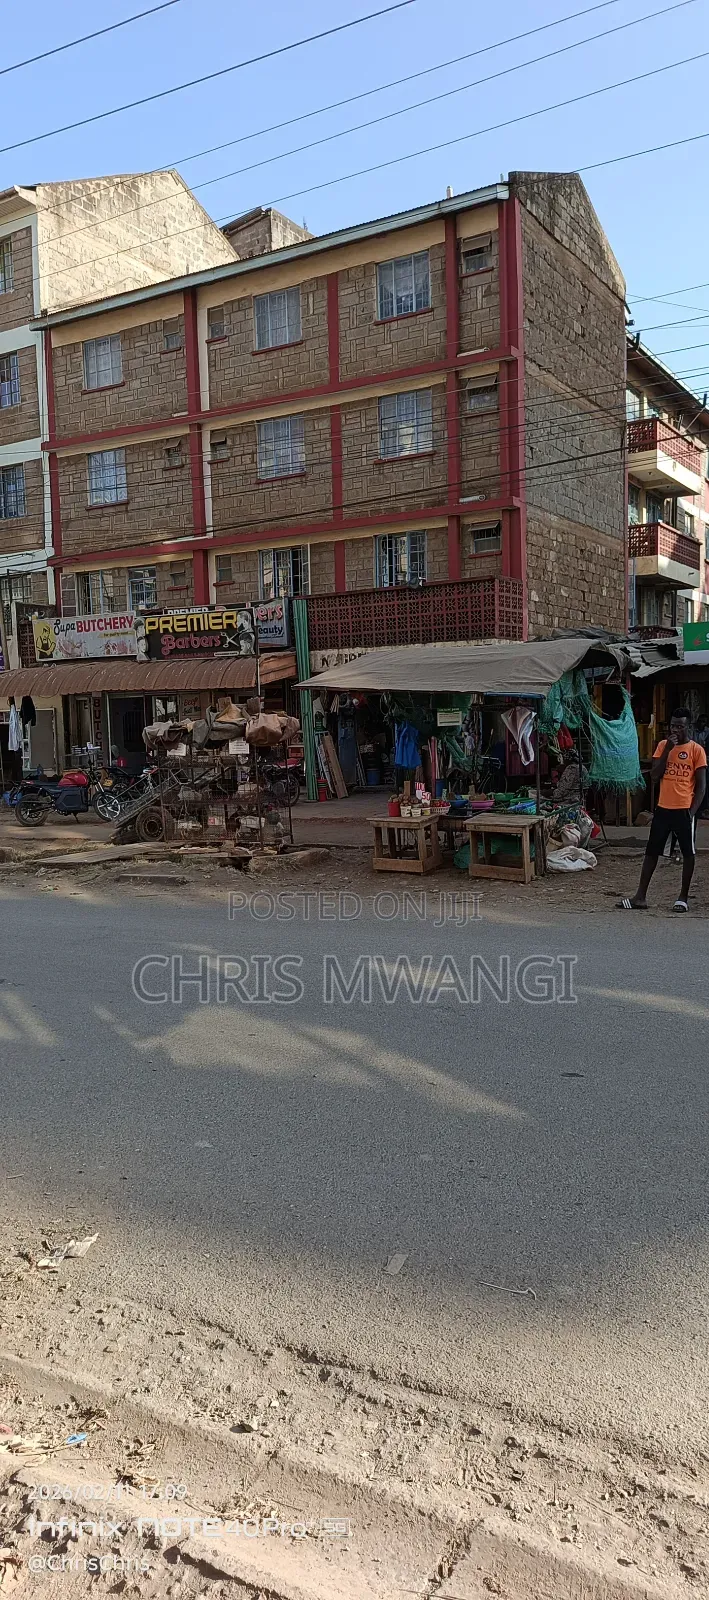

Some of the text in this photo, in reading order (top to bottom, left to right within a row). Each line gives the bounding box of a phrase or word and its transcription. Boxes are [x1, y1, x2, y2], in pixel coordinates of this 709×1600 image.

[53, 616, 133, 637] Supa BUTCHERY
[145, 612, 237, 634] PREMIER
[258, 625, 283, 635] eauty
[161, 634, 221, 655] Barbers
[667, 762, 692, 771] ENYA
[422, 791, 431, 801] 50
